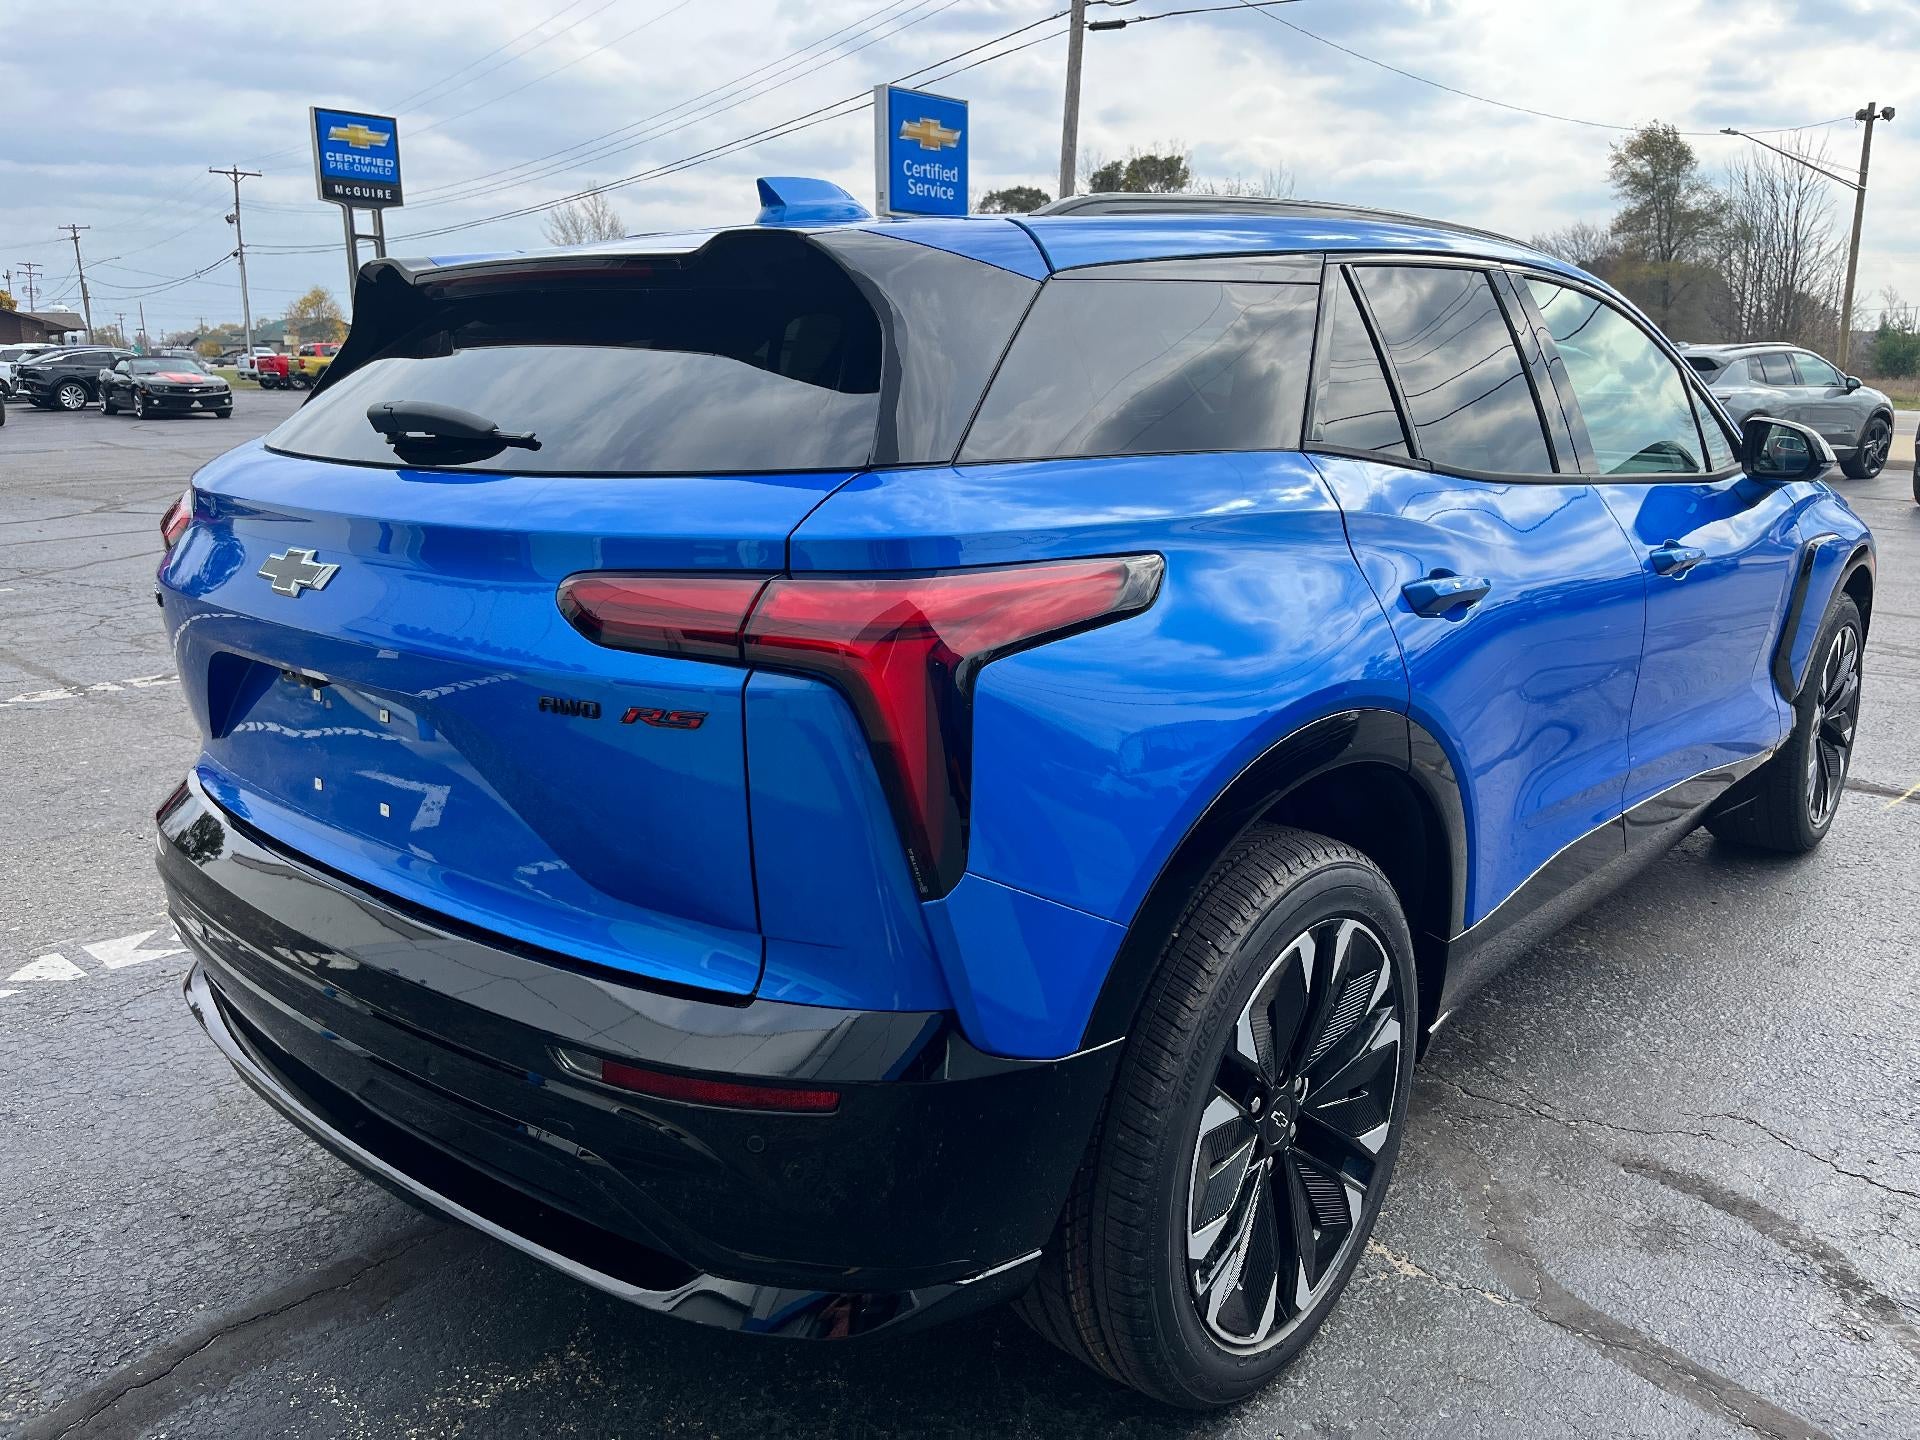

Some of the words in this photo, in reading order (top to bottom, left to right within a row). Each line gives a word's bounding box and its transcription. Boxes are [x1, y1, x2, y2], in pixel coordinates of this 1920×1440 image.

[326, 152, 394, 167] CERTIFIED
[330, 161, 392, 175] PRE-OWNED
[903, 159, 958, 182] Certified
[334, 184, 392, 199] McGUIRE
[908, 179, 954, 200] Service
[538, 696, 602, 720] AWD
[620, 706, 709, 730] RS
